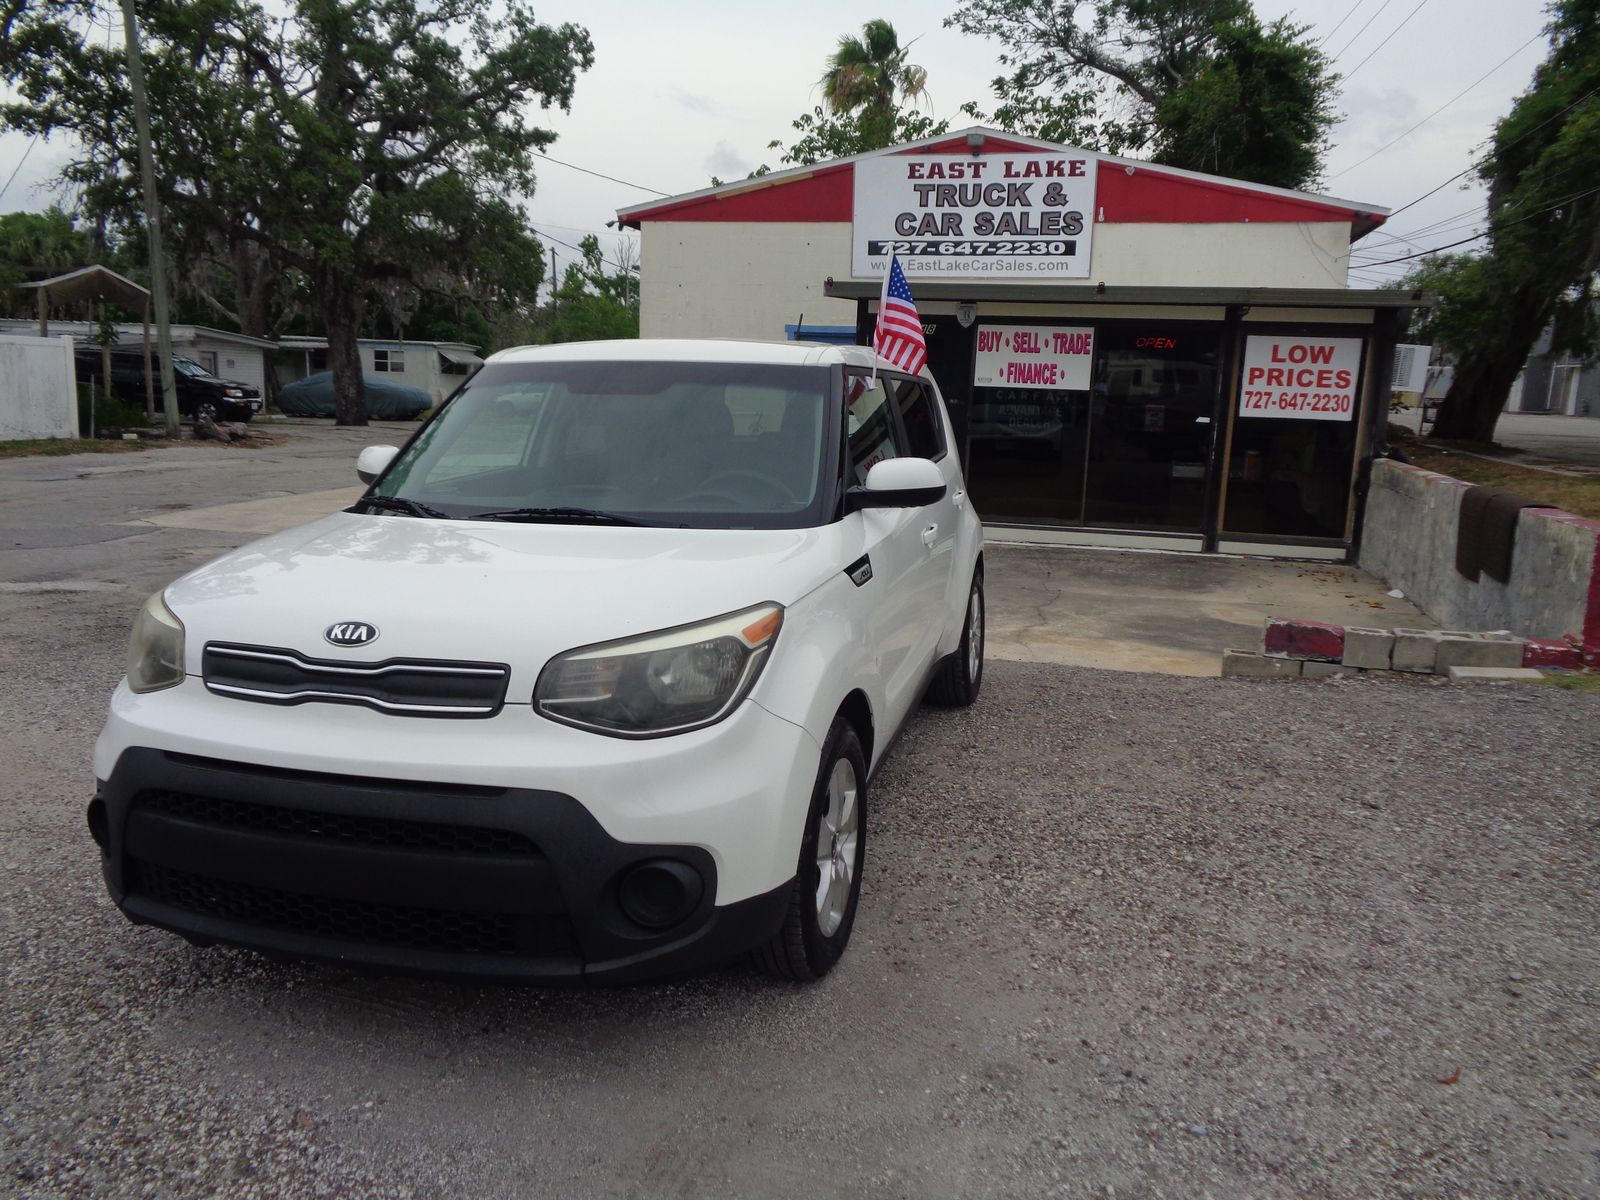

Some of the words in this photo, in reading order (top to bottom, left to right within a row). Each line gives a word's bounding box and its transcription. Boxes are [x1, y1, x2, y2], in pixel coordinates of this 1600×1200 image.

[908, 162, 987, 179] EAST
[1004, 160, 1086, 177] LAKE
[914, 183, 1033, 207] TRUCK
[1043, 182, 1069, 206] &
[895, 212, 964, 236] CAR
[973, 211, 1084, 236] SALES
[878, 241, 1066, 255] 727-647-2230
[978, 331, 1003, 352] BUY
[1013, 332, 1041, 353] SELL
[1052, 334, 1091, 354] TRADE
[1136, 337, 1176, 349] OPEN
[1271, 345, 1335, 364] LOW
[1006, 362, 1057, 384] FINANCE
[1248, 367, 1351, 389] PRICES
[1244, 391, 1350, 412] 727-647-2230
[330, 624, 367, 640] KIA
